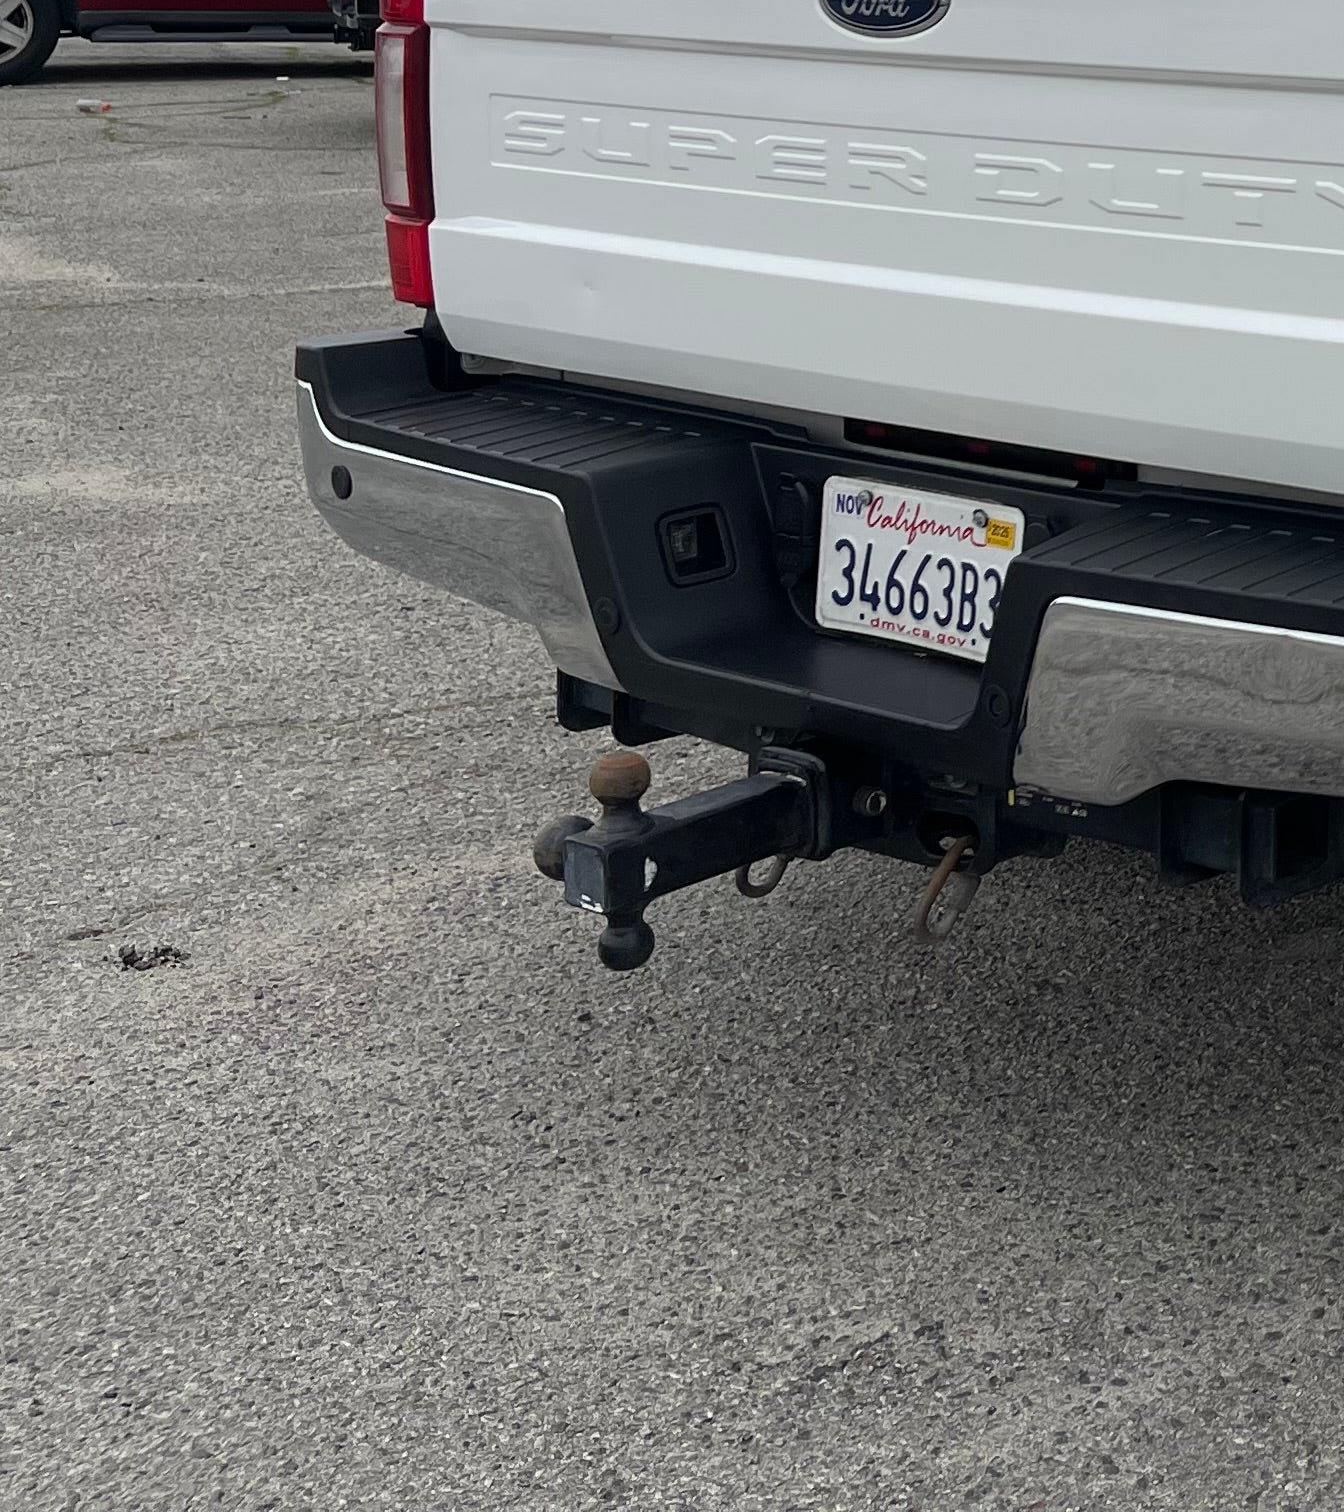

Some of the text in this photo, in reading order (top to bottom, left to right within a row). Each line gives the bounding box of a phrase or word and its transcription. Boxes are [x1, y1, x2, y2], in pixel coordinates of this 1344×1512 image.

[504, 110, 926, 195] SUPER
[836, 493, 987, 548] NOV California
[831, 538, 1001, 639] 34663B3
[870, 617, 967, 648] dmv.ca.gov
